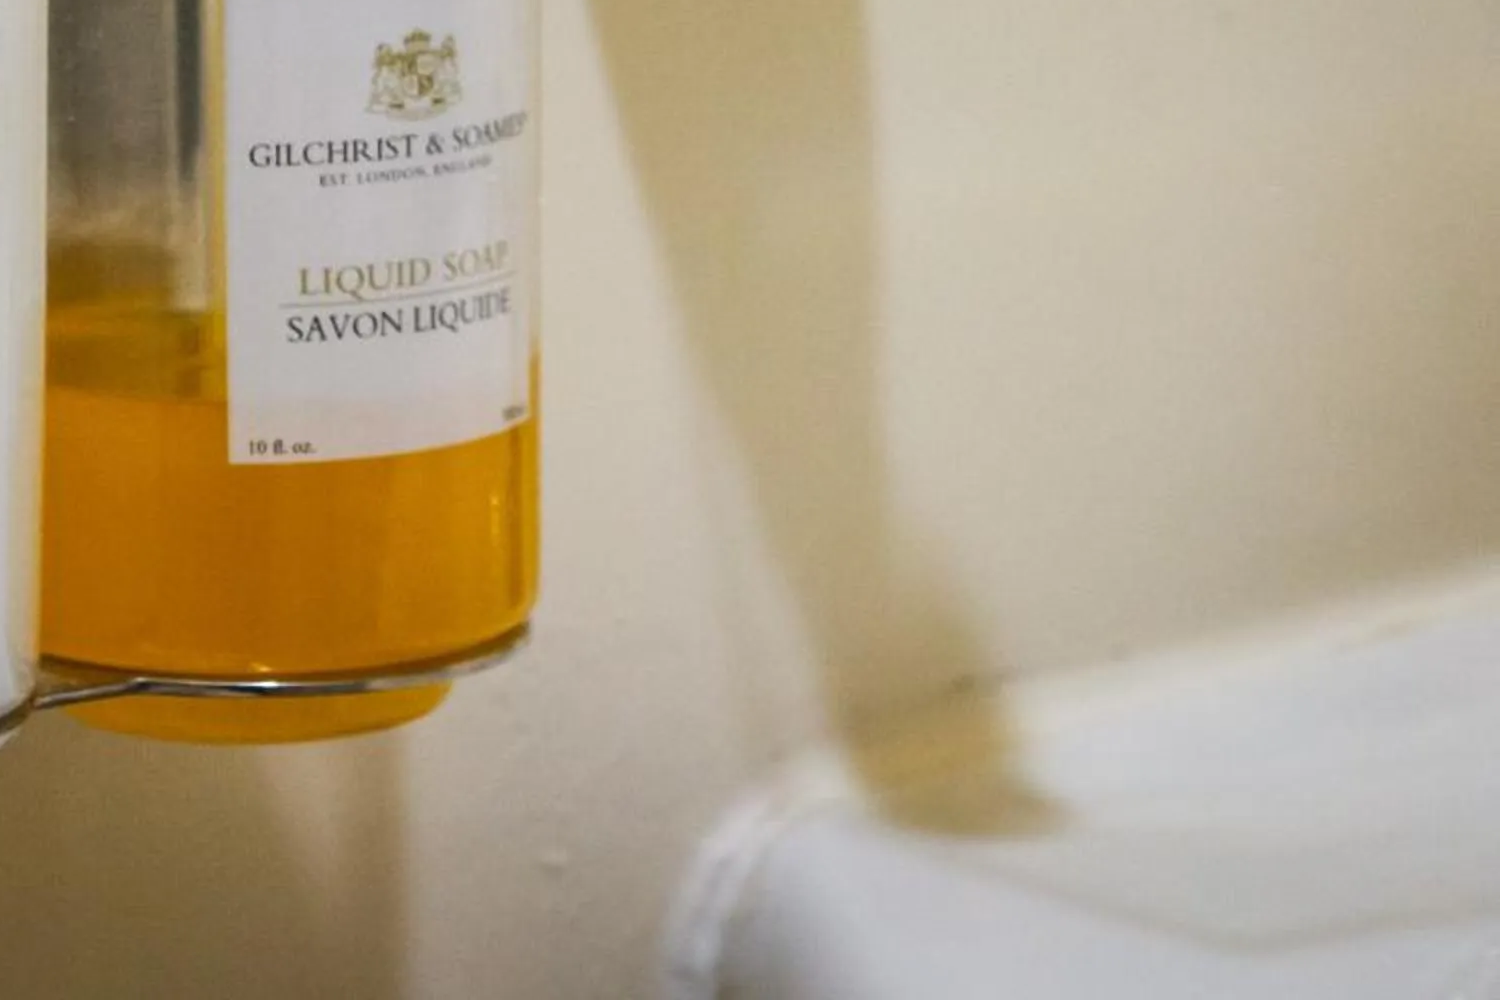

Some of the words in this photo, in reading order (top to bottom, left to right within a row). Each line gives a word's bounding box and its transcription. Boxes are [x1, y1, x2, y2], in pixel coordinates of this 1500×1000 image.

[248, 134, 419, 169] GILCHRIST
[425, 136, 444, 156] &
[299, 257, 432, 302] LIQUID
[286, 308, 403, 344] SAVON
